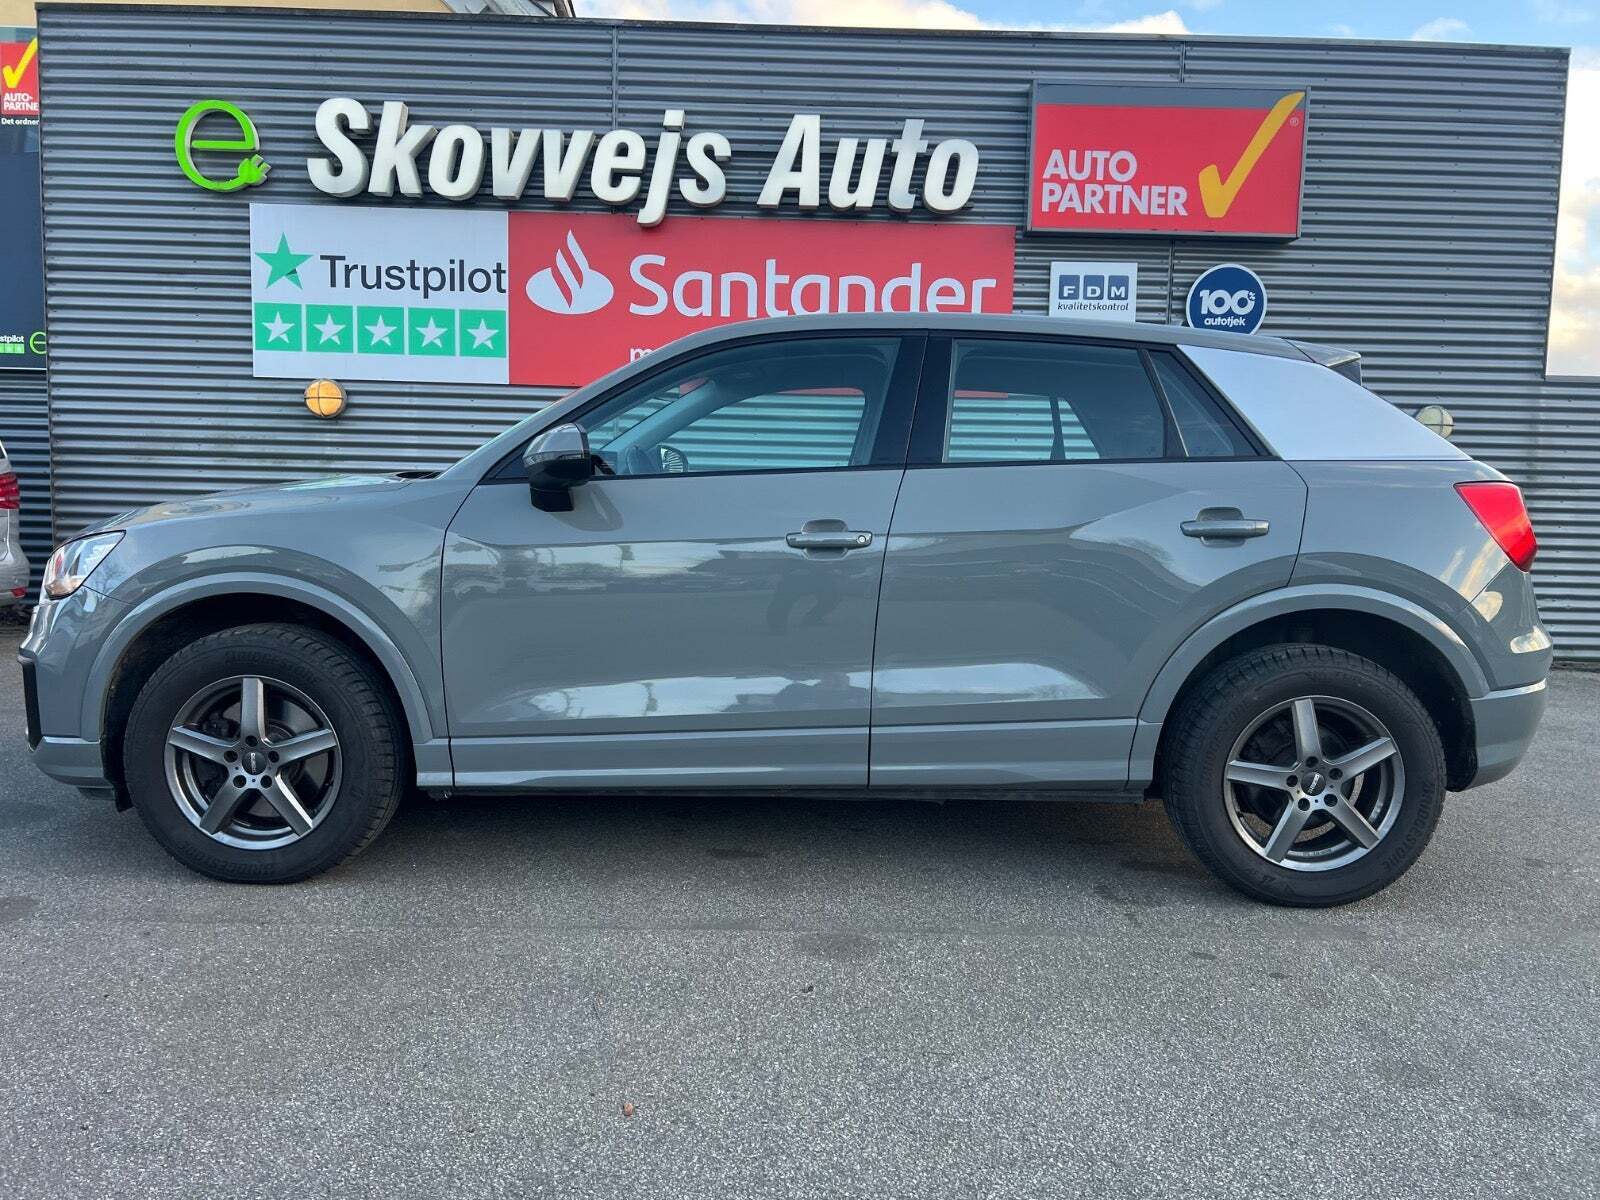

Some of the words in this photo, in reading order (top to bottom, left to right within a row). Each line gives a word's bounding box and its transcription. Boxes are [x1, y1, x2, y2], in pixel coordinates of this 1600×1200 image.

[306, 97, 732, 227] Skovvejs
[757, 114, 981, 214] Auto
[1043, 149, 1138, 182] AUTO
[1041, 183, 1188, 216] PARTNER
[320, 254, 507, 299] Trustpilot
[629, 254, 997, 317] Santander
[1057, 302, 1129, 311] kvalitetskontrol
[1204, 316, 1246, 328] autotjek
